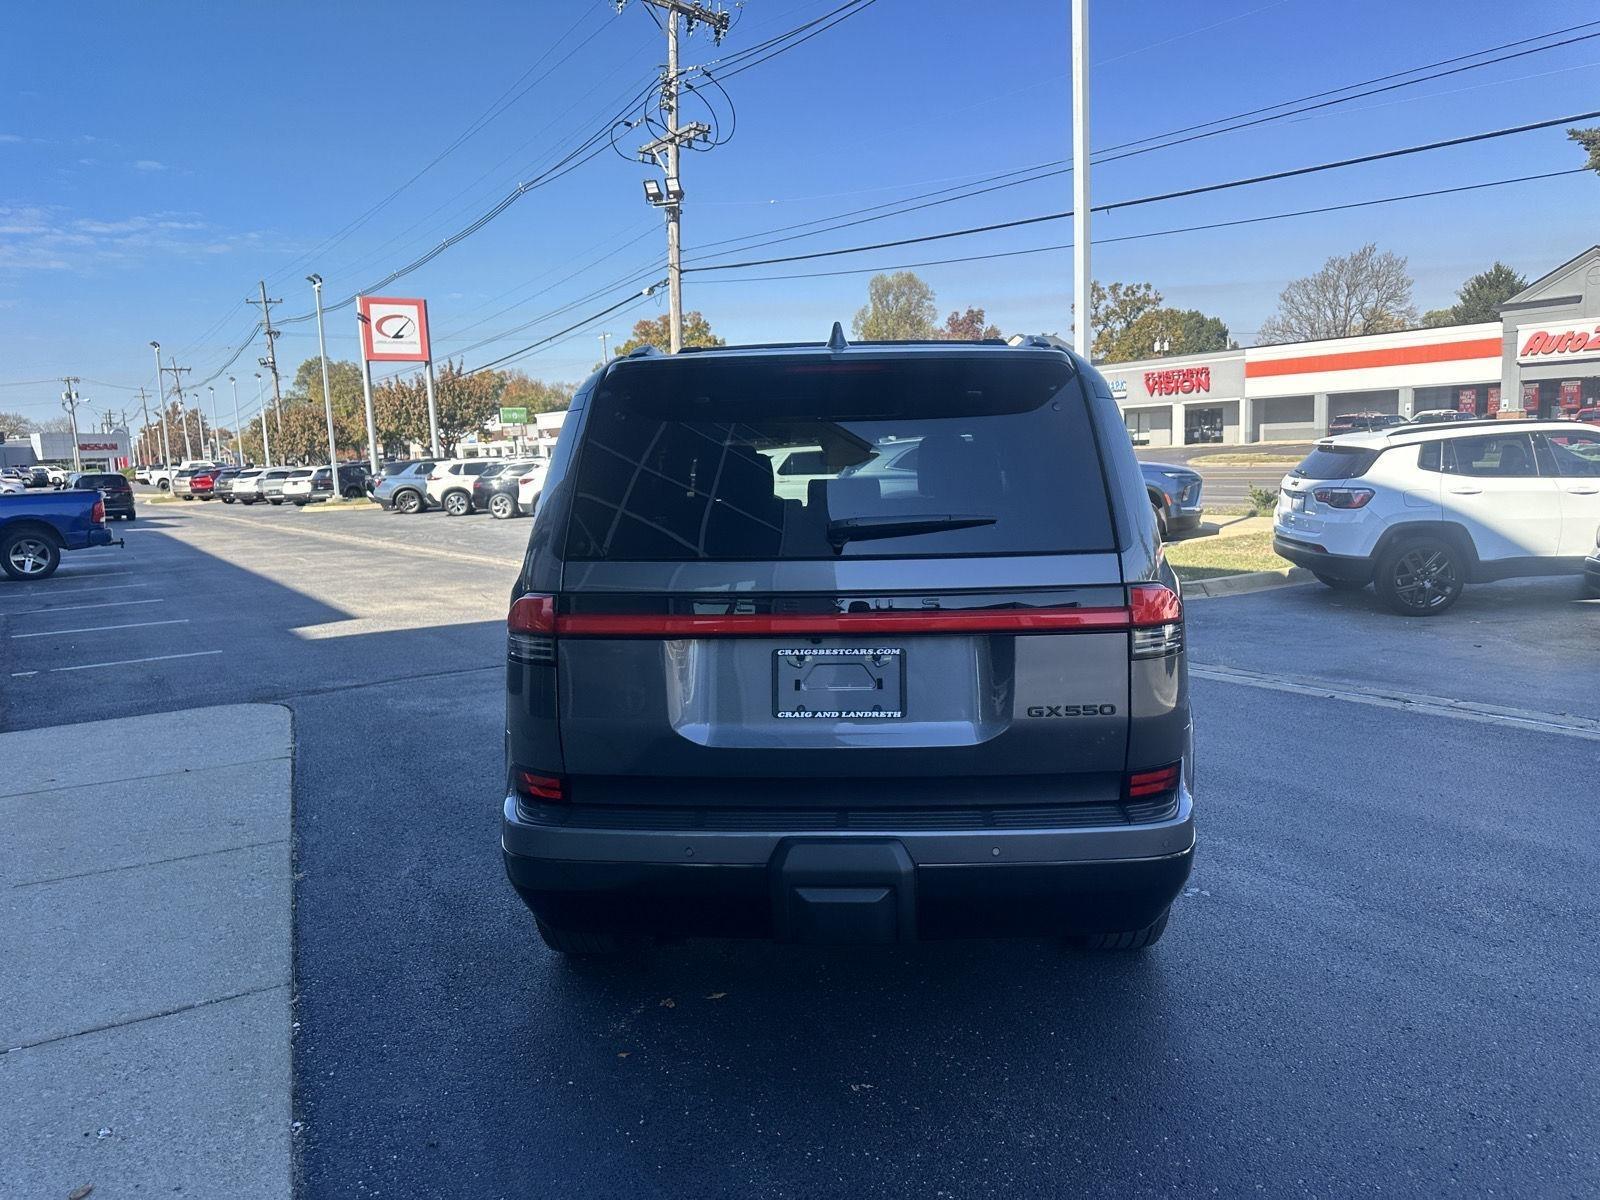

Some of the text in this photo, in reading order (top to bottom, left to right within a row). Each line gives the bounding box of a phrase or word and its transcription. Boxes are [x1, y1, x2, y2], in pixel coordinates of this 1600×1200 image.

[1144, 375, 1210, 397] VISION
[78, 443, 118, 451] NISSAN
[777, 648, 901, 656] CRAIGSBESTCARS.COM
[1027, 703, 1117, 718] GX550
